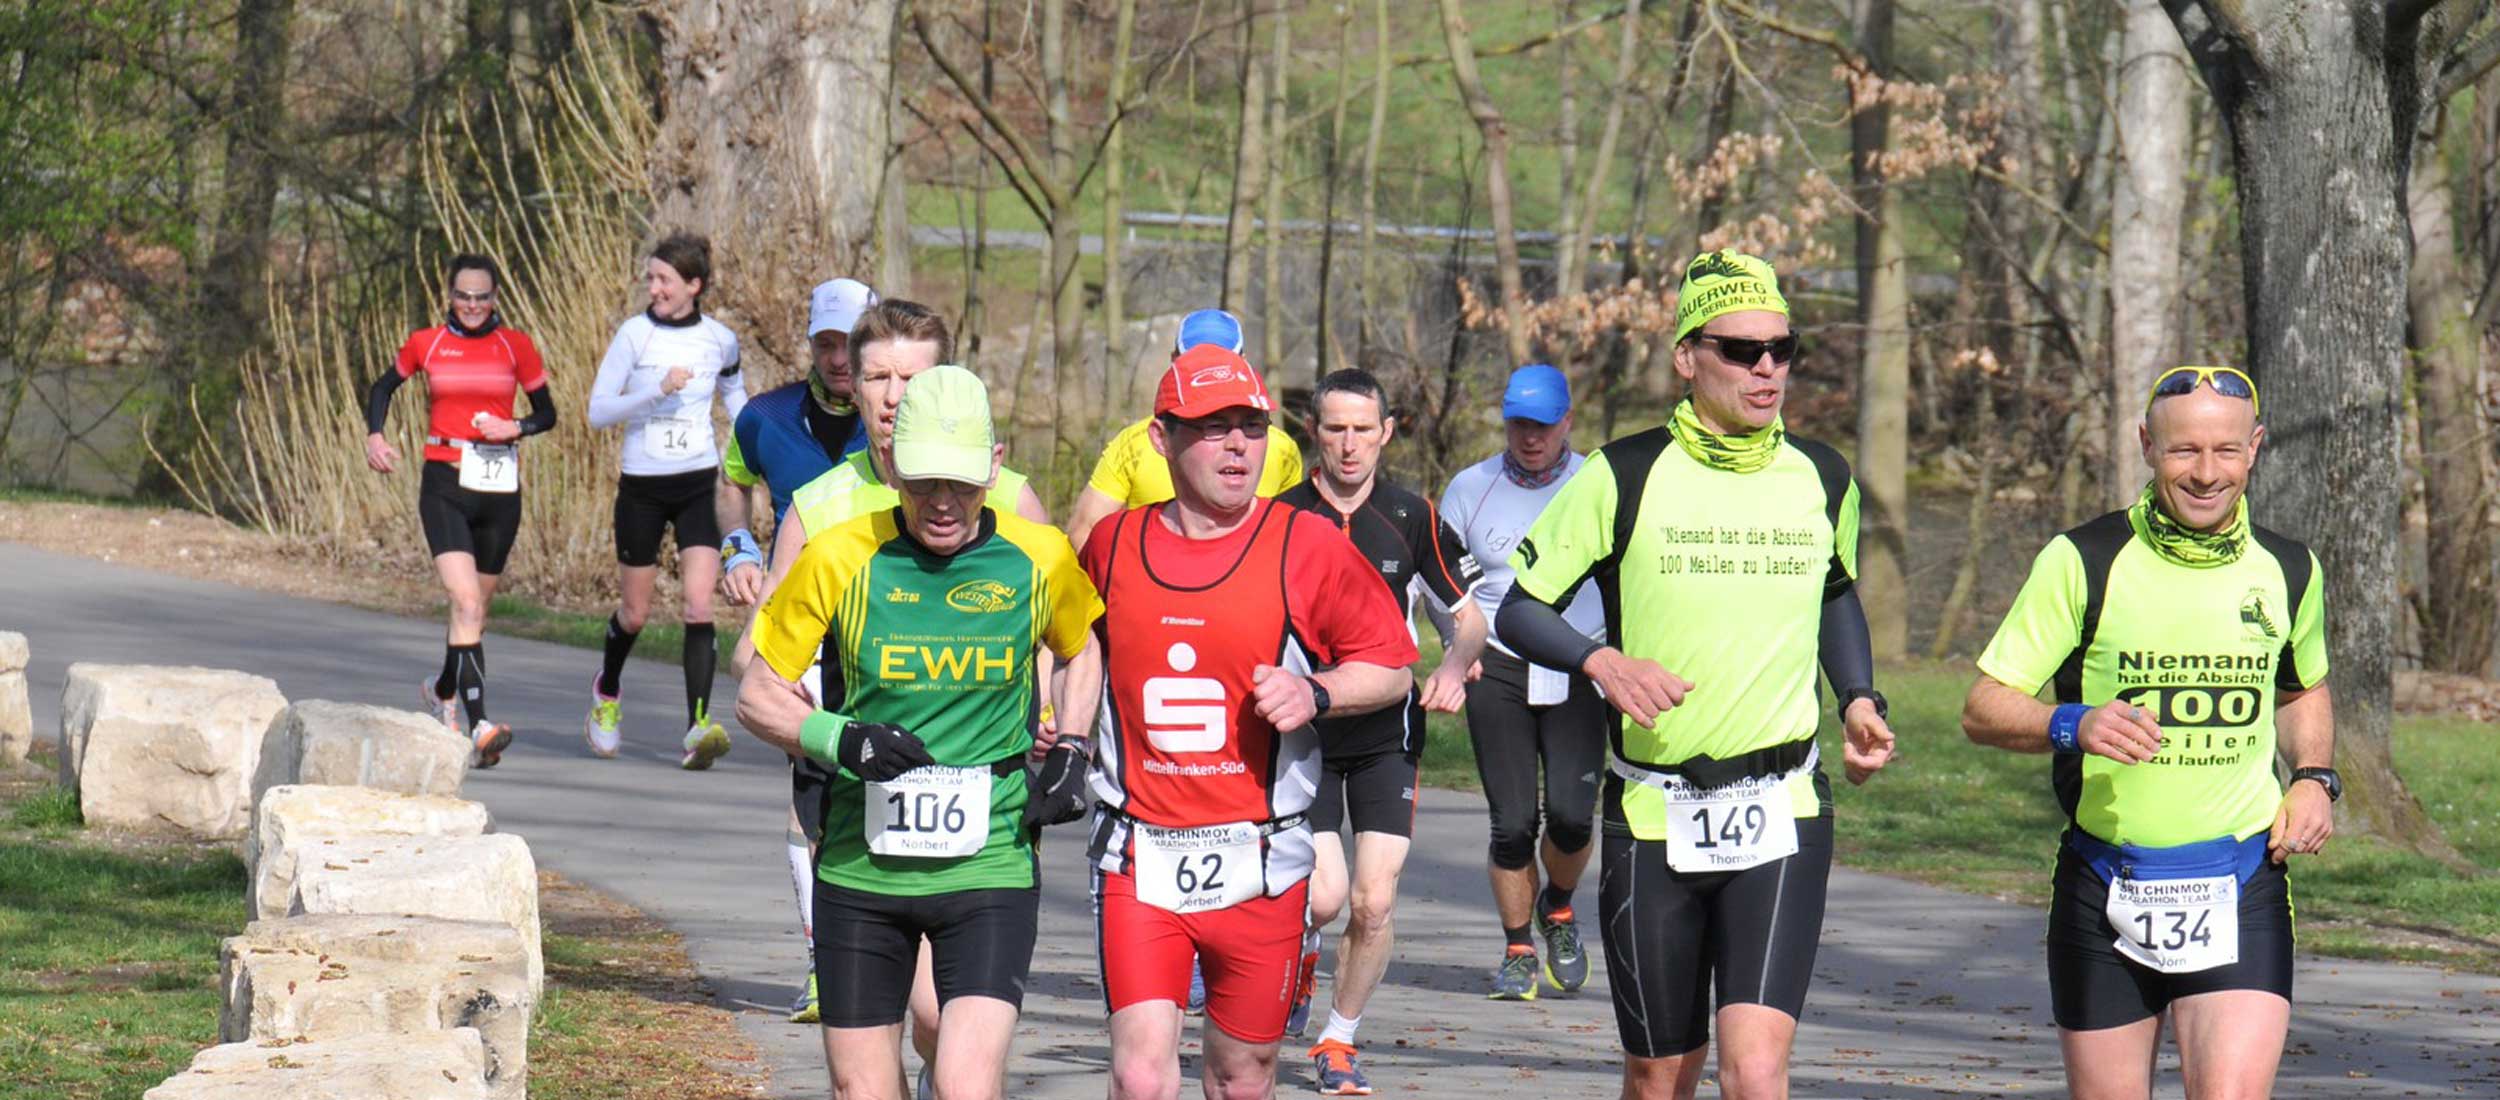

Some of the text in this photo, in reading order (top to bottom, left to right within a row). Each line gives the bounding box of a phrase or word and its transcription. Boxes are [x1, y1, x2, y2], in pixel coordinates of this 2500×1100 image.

[1701, 296, 1743, 317] BERLIN
[664, 430, 687, 449] 14
[481, 460, 504, 479] 17
[1720, 527, 1740, 544] hat
[1746, 528, 1766, 545] die
[1660, 555, 1682, 574] 100
[1689, 555, 1735, 574] Meilen
[1743, 562, 1757, 574] zu
[880, 644, 1014, 681] EWH
[2118, 651, 2269, 670] Niemand
[2117, 672, 2150, 684] hat
[2158, 672, 2188, 684] die
[2130, 689, 2256, 724] 100
[2159, 734, 2256, 748] eilen
[2149, 755, 2240, 766] zu laufen!
[1736, 788, 1760, 797] TEAM
[887, 792, 965, 833] 106
[1168, 828, 1230, 839] CHINMOY
[1692, 804, 1766, 848] 149
[901, 839, 949, 850] Norbert
[1203, 837, 1231, 847] TEAM
[1176, 853, 1224, 893] 62
[2144, 883, 2210, 895] CHINMOY
[2182, 894, 2211, 903] TEAM
[2134, 909, 2211, 951] 134
